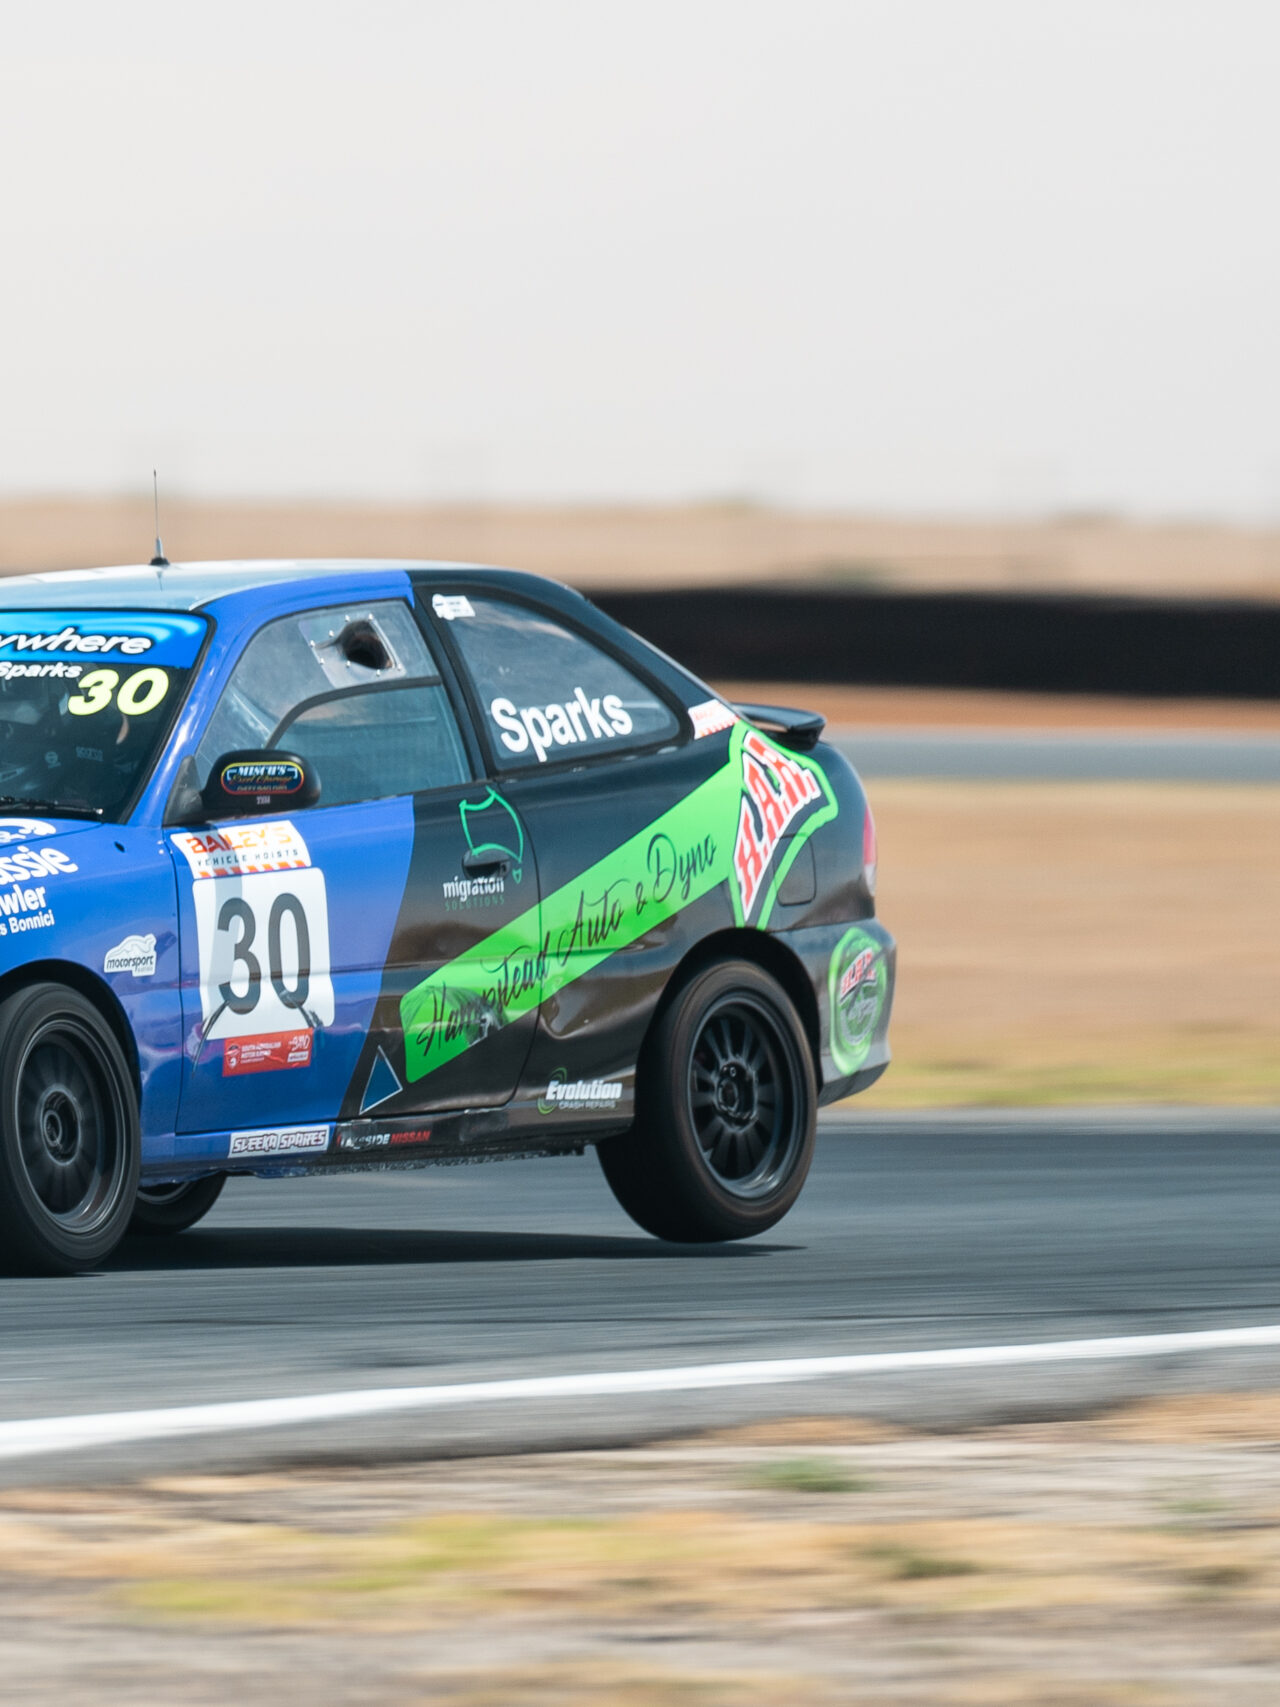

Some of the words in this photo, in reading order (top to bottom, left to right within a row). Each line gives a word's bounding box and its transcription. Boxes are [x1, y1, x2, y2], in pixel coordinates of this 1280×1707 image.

[68, 668, 169, 716] 30
[491, 687, 634, 763] Sparks
[255, 849, 299, 860] HOISTS
[442, 875, 505, 902] migration
[557, 878, 630, 967] Auto
[636, 881, 648, 916] &
[647, 833, 717, 903] Dyno
[8, 908, 55, 934] Bonnici
[217, 892, 311, 1015] 30
[545, 1079, 623, 1101] Evolution
[278, 1128, 327, 1149] SPARES
[391, 1130, 431, 1144] NISSAN
